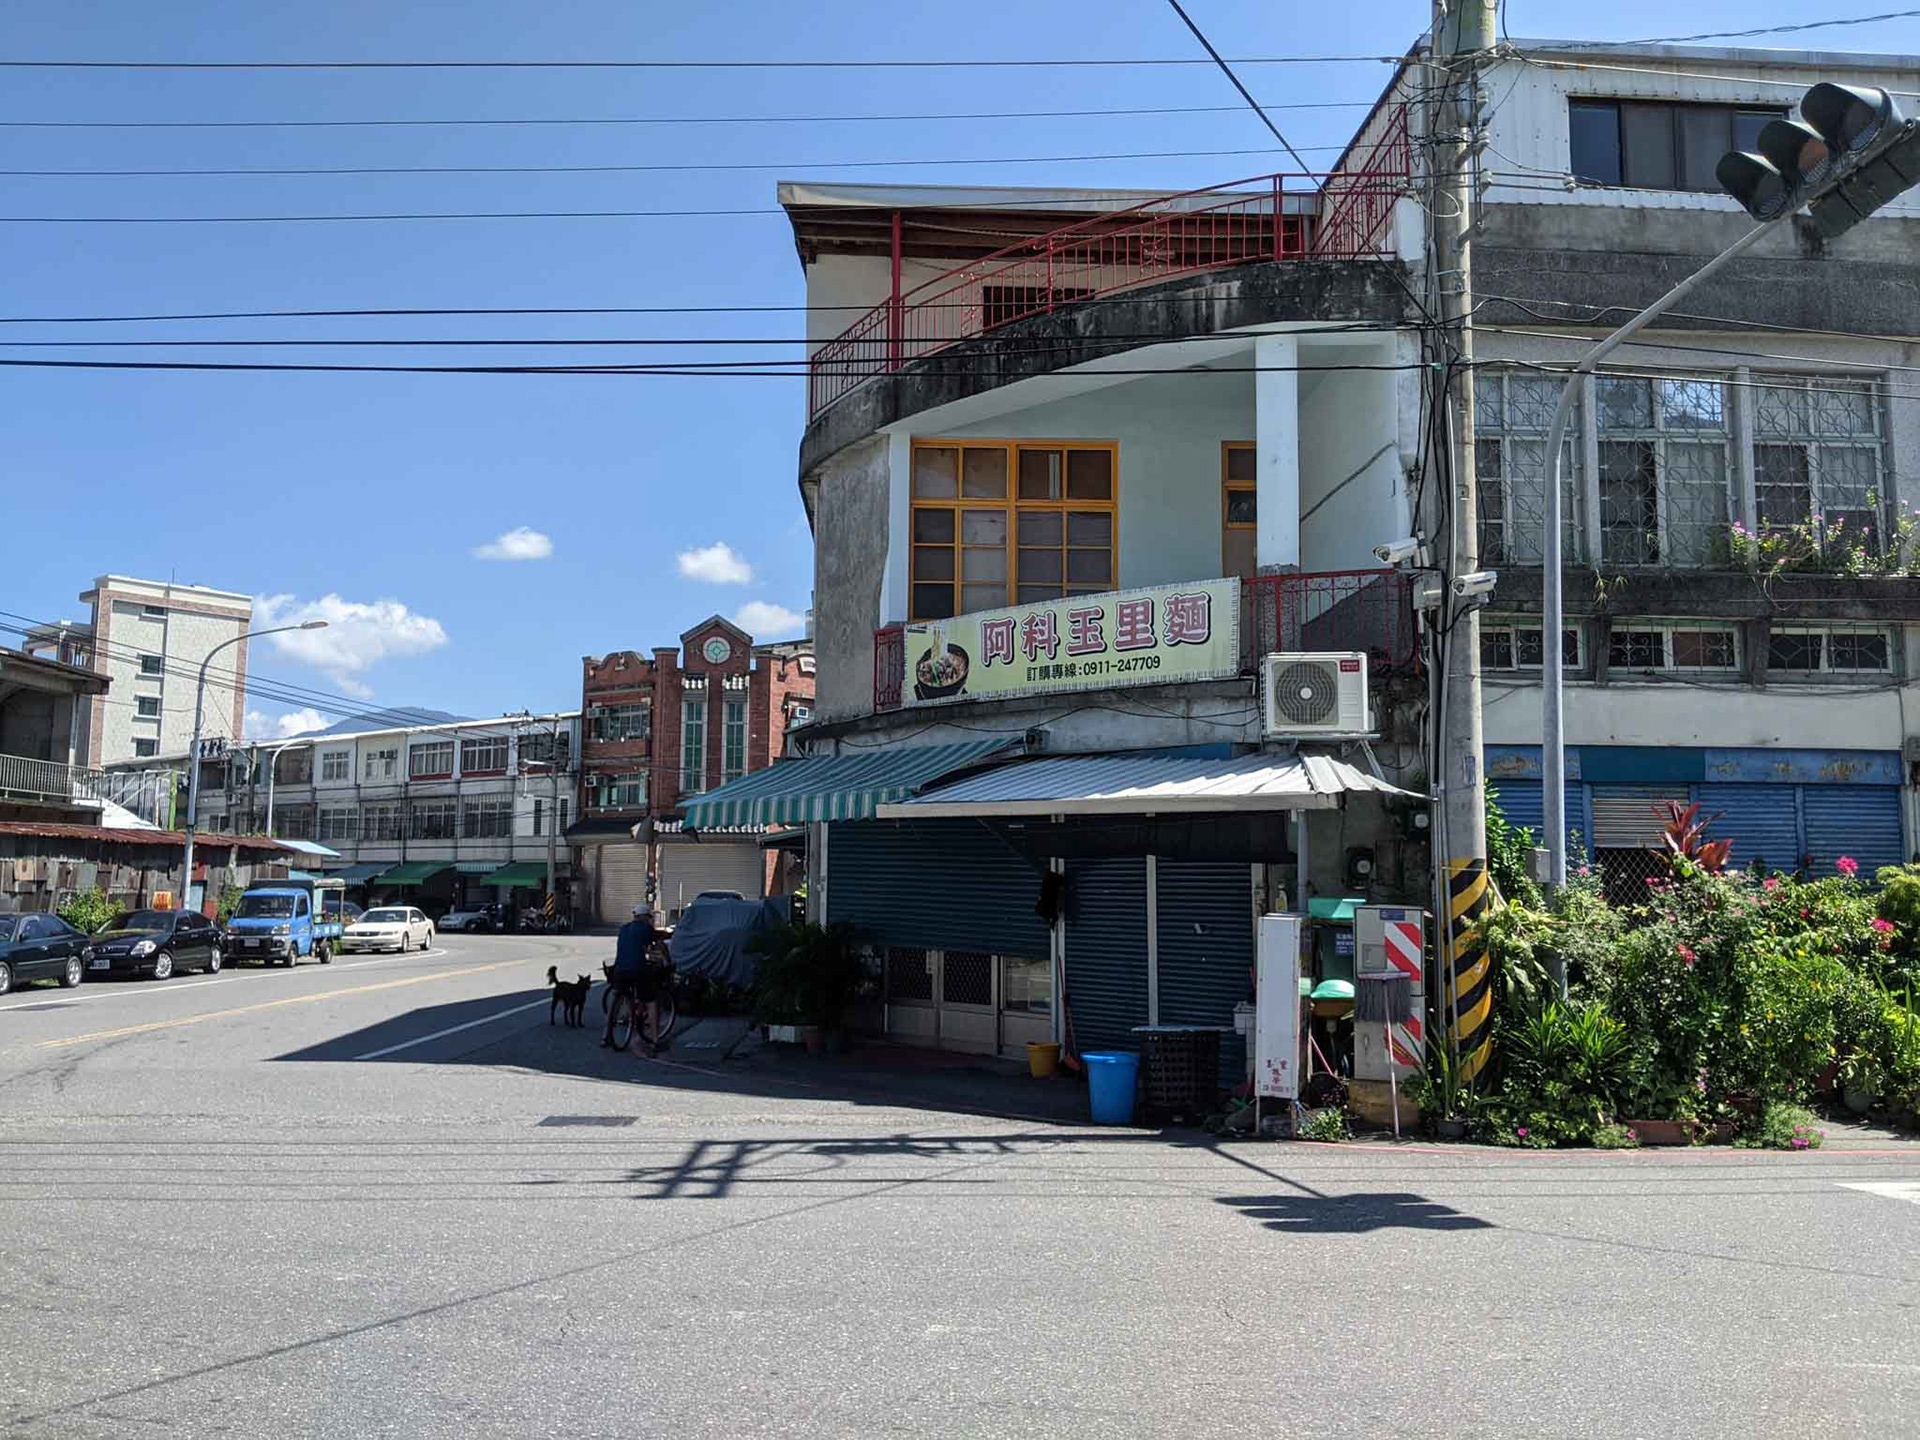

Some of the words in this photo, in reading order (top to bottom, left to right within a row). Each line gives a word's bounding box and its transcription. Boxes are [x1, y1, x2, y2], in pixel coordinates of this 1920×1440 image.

[981, 592, 1211, 666] 阿科玉里麵
